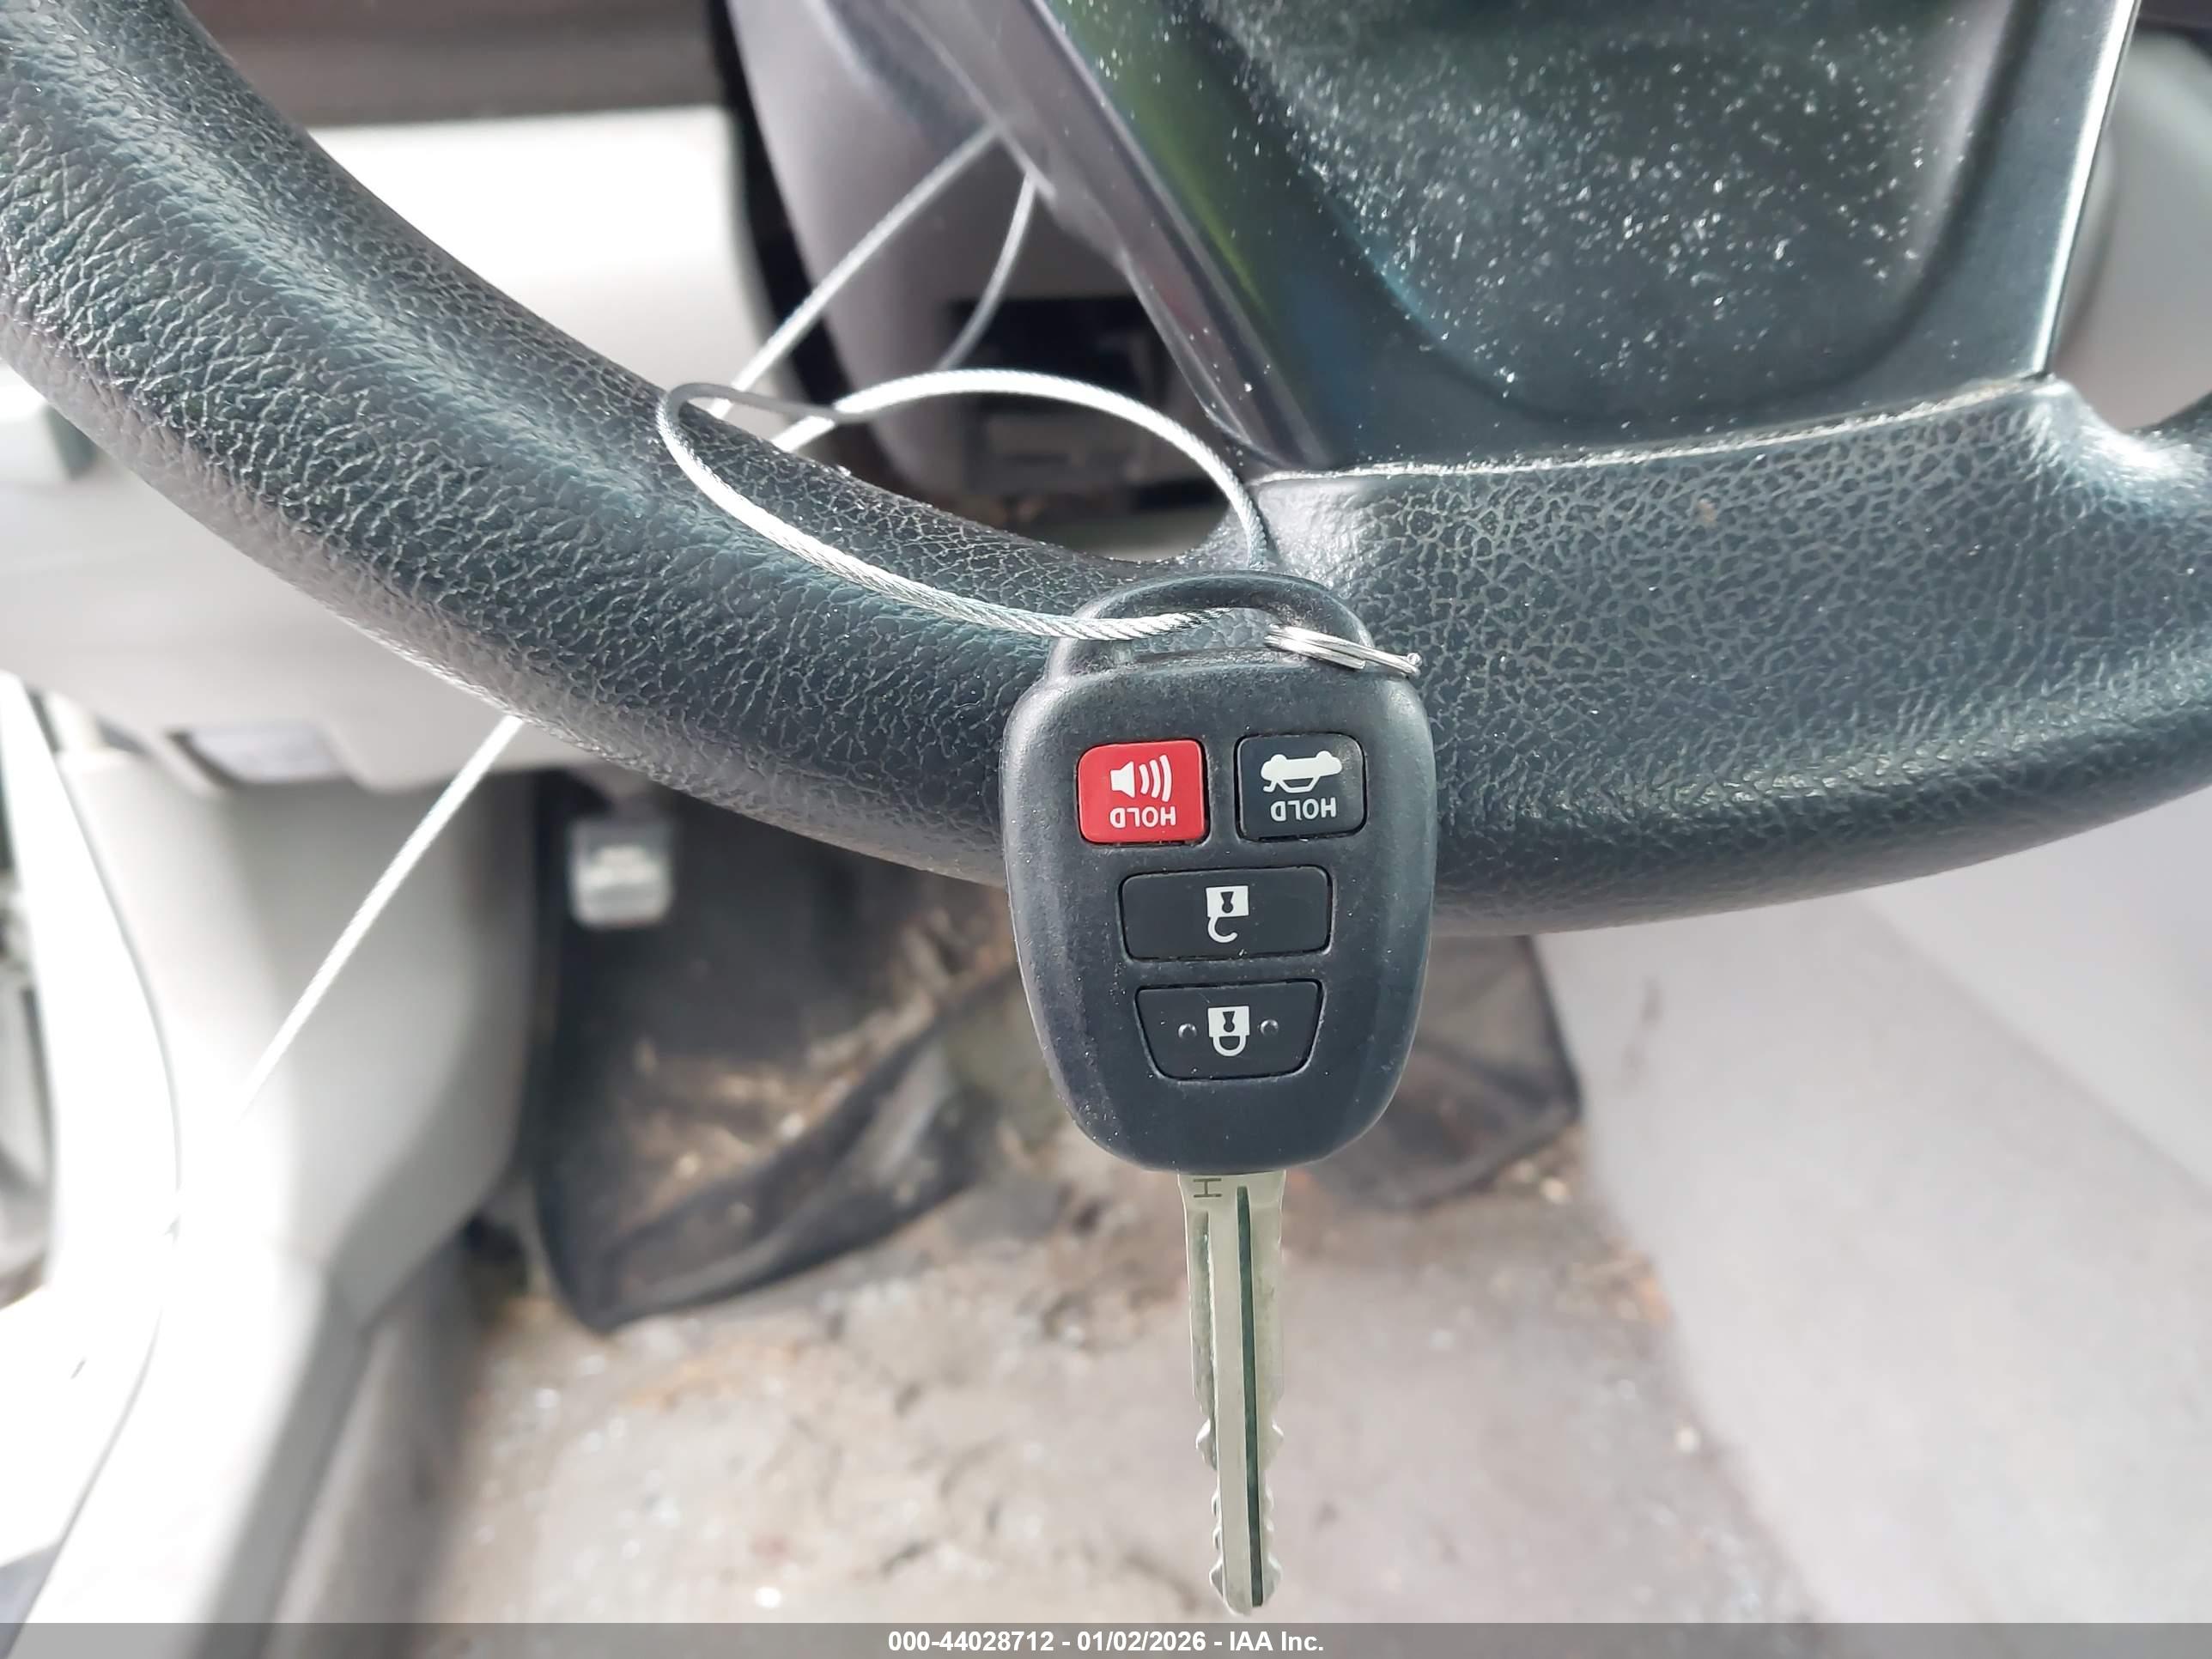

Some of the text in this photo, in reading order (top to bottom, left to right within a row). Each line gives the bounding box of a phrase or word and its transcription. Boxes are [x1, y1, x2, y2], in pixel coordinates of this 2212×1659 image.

[1109, 805, 1176, 829] HOLD
[1270, 797, 1337, 822] HOLD
[1193, 1177, 1223, 1199] H
